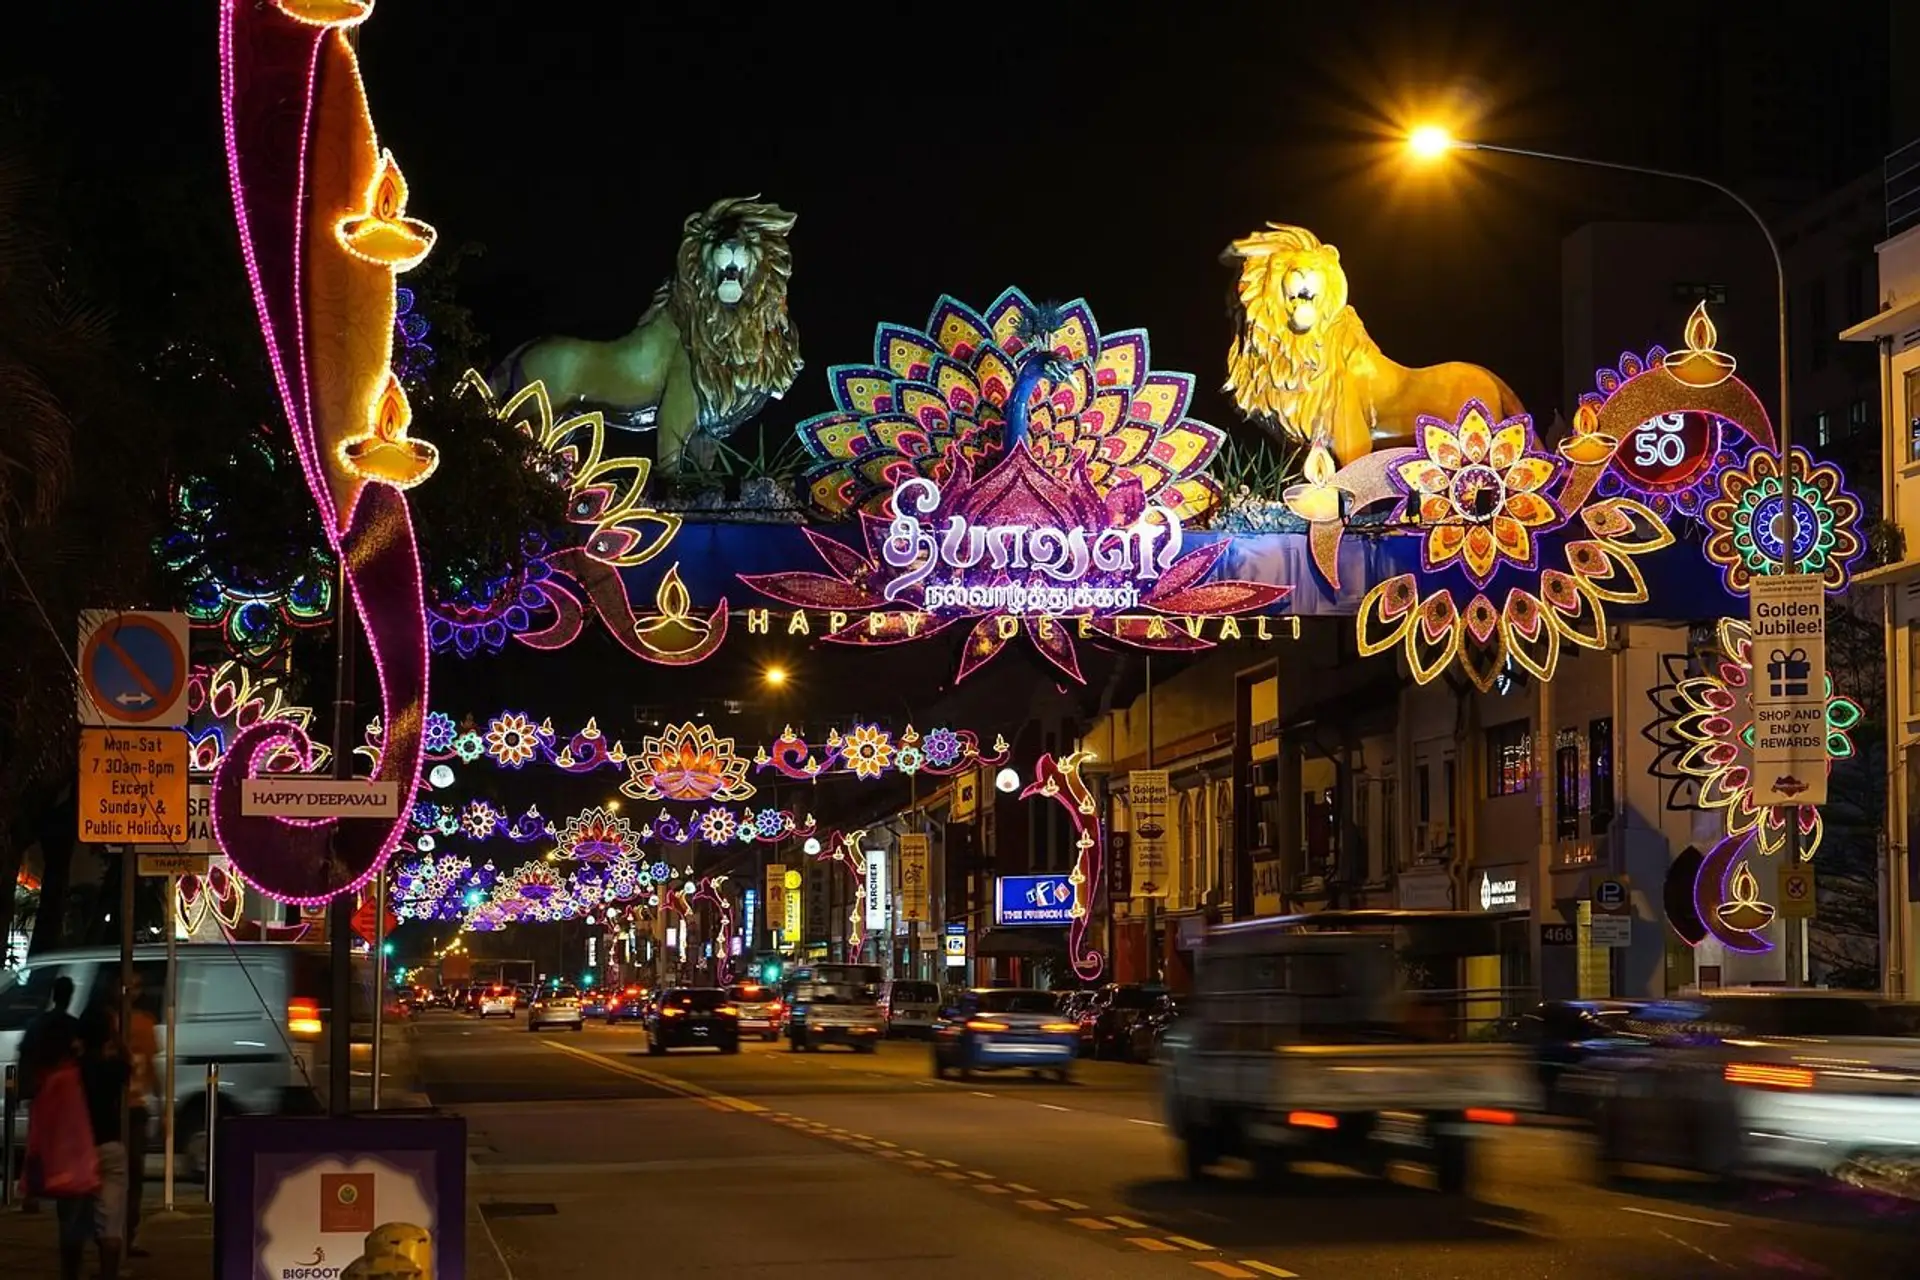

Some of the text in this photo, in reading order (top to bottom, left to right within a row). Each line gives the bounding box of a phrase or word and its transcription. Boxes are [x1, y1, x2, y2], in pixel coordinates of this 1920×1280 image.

[1635, 433, 1685, 466] 50
[883, 478, 1183, 601] தீபாவளி
[923, 578, 1141, 615] நல்வாழ்த்துக்கள்
[1756, 601, 1820, 618] Golden
[748, 609, 921, 637] HAPPY
[1753, 618, 1823, 636] Jubilee!
[1758, 709, 1821, 721] SHOP AND
[1770, 723, 1810, 734] ENJOY
[104, 736, 162, 753] Mon-Sat
[1760, 736, 1821, 749] REWARDS
[111, 780, 155, 797] Except
[1132, 784, 1166, 795] Golden
[252, 791, 387, 806] HAPPY DEEPAVALI
[100, 798, 166, 817] Sunday &
[85, 819, 182, 838] Public Holidays
[1004, 910, 1023, 920] THE
[1544, 927, 1574, 942] 468
[283, 1268, 340, 1280] BIGFOOT
